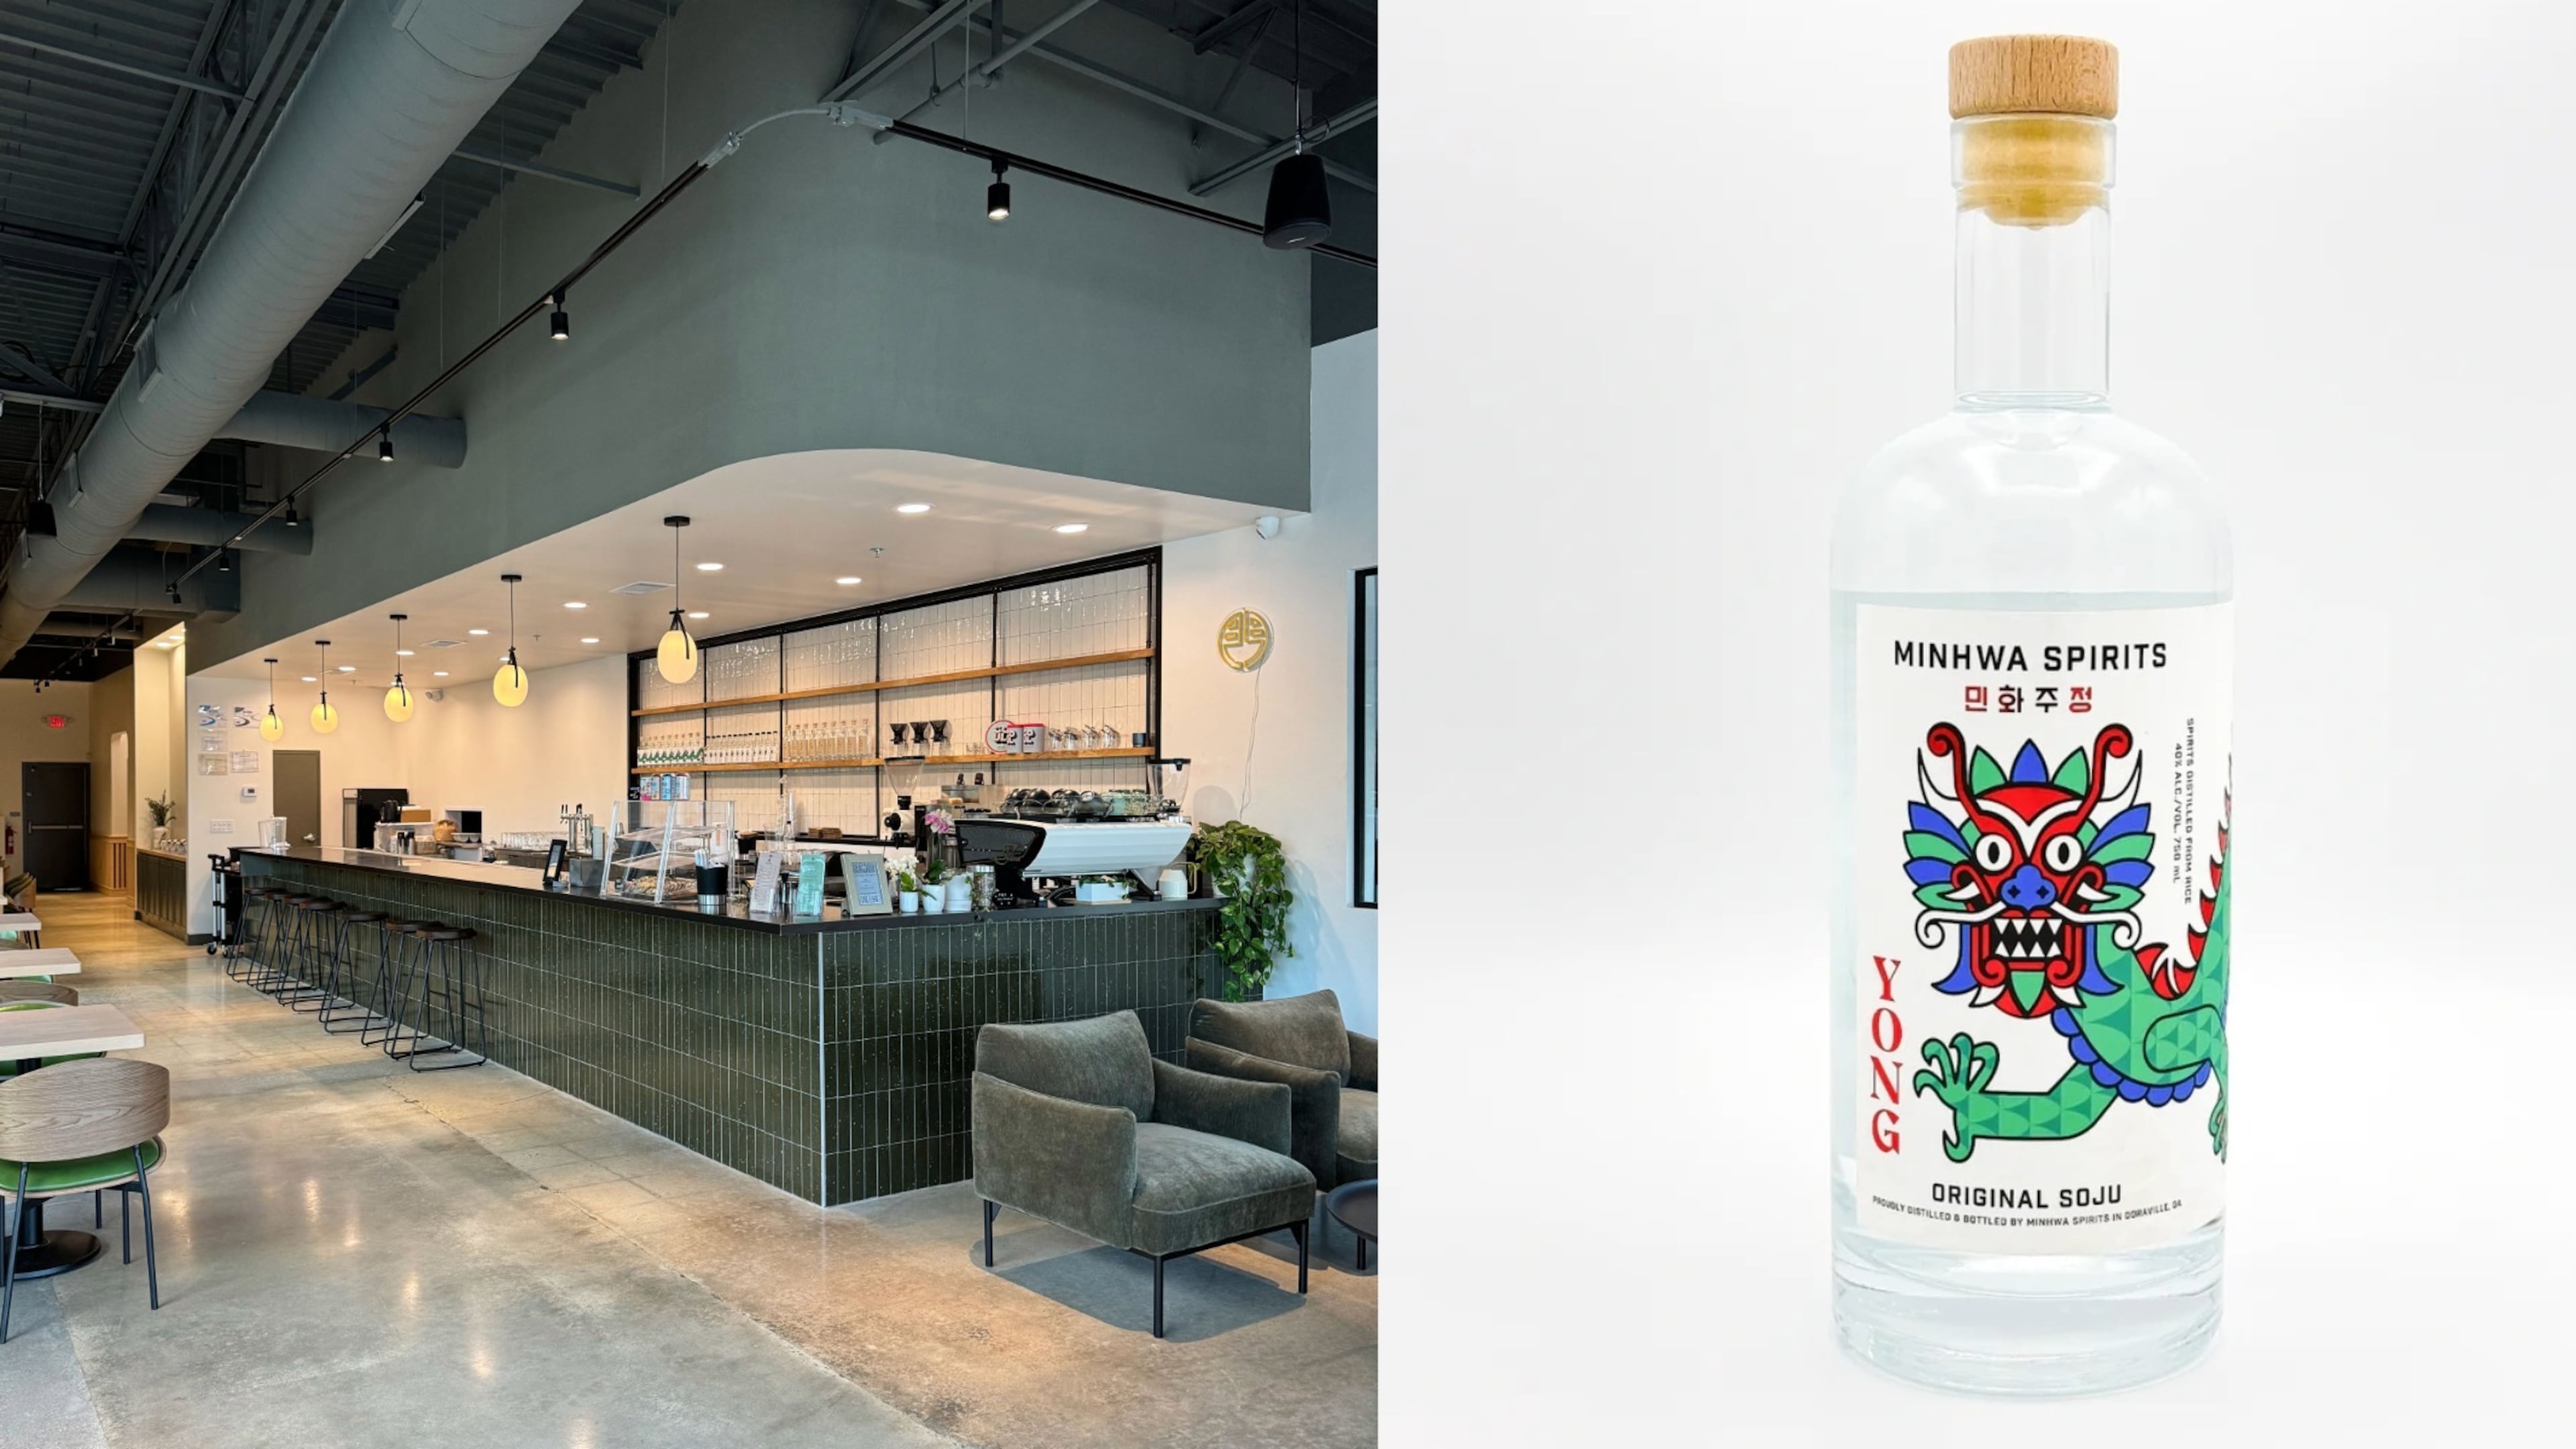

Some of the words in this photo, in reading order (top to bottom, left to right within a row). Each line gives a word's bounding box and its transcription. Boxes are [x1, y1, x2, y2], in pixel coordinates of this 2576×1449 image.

[1894, 640, 2028, 672] MINHWA
[2044, 643, 2166, 672] SPIRITS
[1965, 684, 2092, 713] 민화주정
[2186, 771, 2194, 833] DISTILLED
[1870, 955, 1902, 1154] YONG
[1872, 1195, 1905, 1213] PROUDLY
[1907, 1205, 1951, 1222] DISTILLED
[1953, 1214, 1960, 1222] &
[1964, 1214, 2007, 1226] BOTTLED
[2010, 1218, 2023, 1226] BY
[2027, 1217, 2070, 1226] MINHWA
[2072, 1214, 2110, 1226] SPIRITS
[2112, 1213, 2122, 1222] IN
[1932, 1183, 2049, 1209] ORIGINAL
[2059, 1184, 2121, 1208] SOJU
